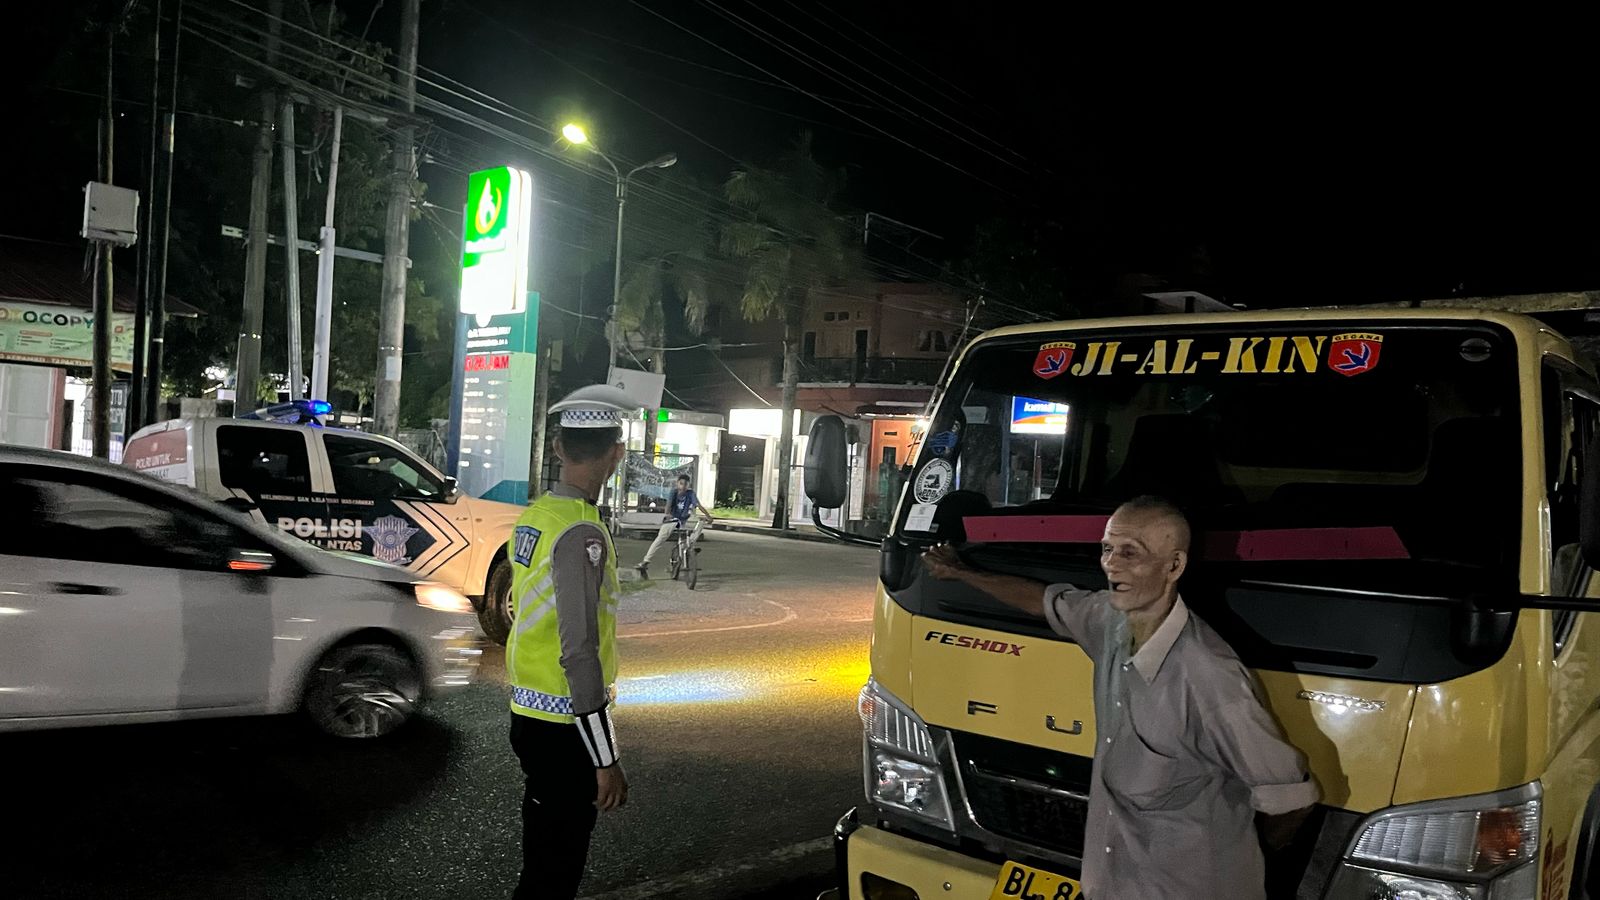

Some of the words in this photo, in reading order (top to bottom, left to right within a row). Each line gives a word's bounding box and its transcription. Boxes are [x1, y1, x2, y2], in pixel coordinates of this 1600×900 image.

[1333, 333, 1383, 343] GEGANA
[1071, 335, 1327, 377] JI-AL-KIN
[278, 517, 362, 538] POLISI
[1003, 866, 1034, 900] BL
